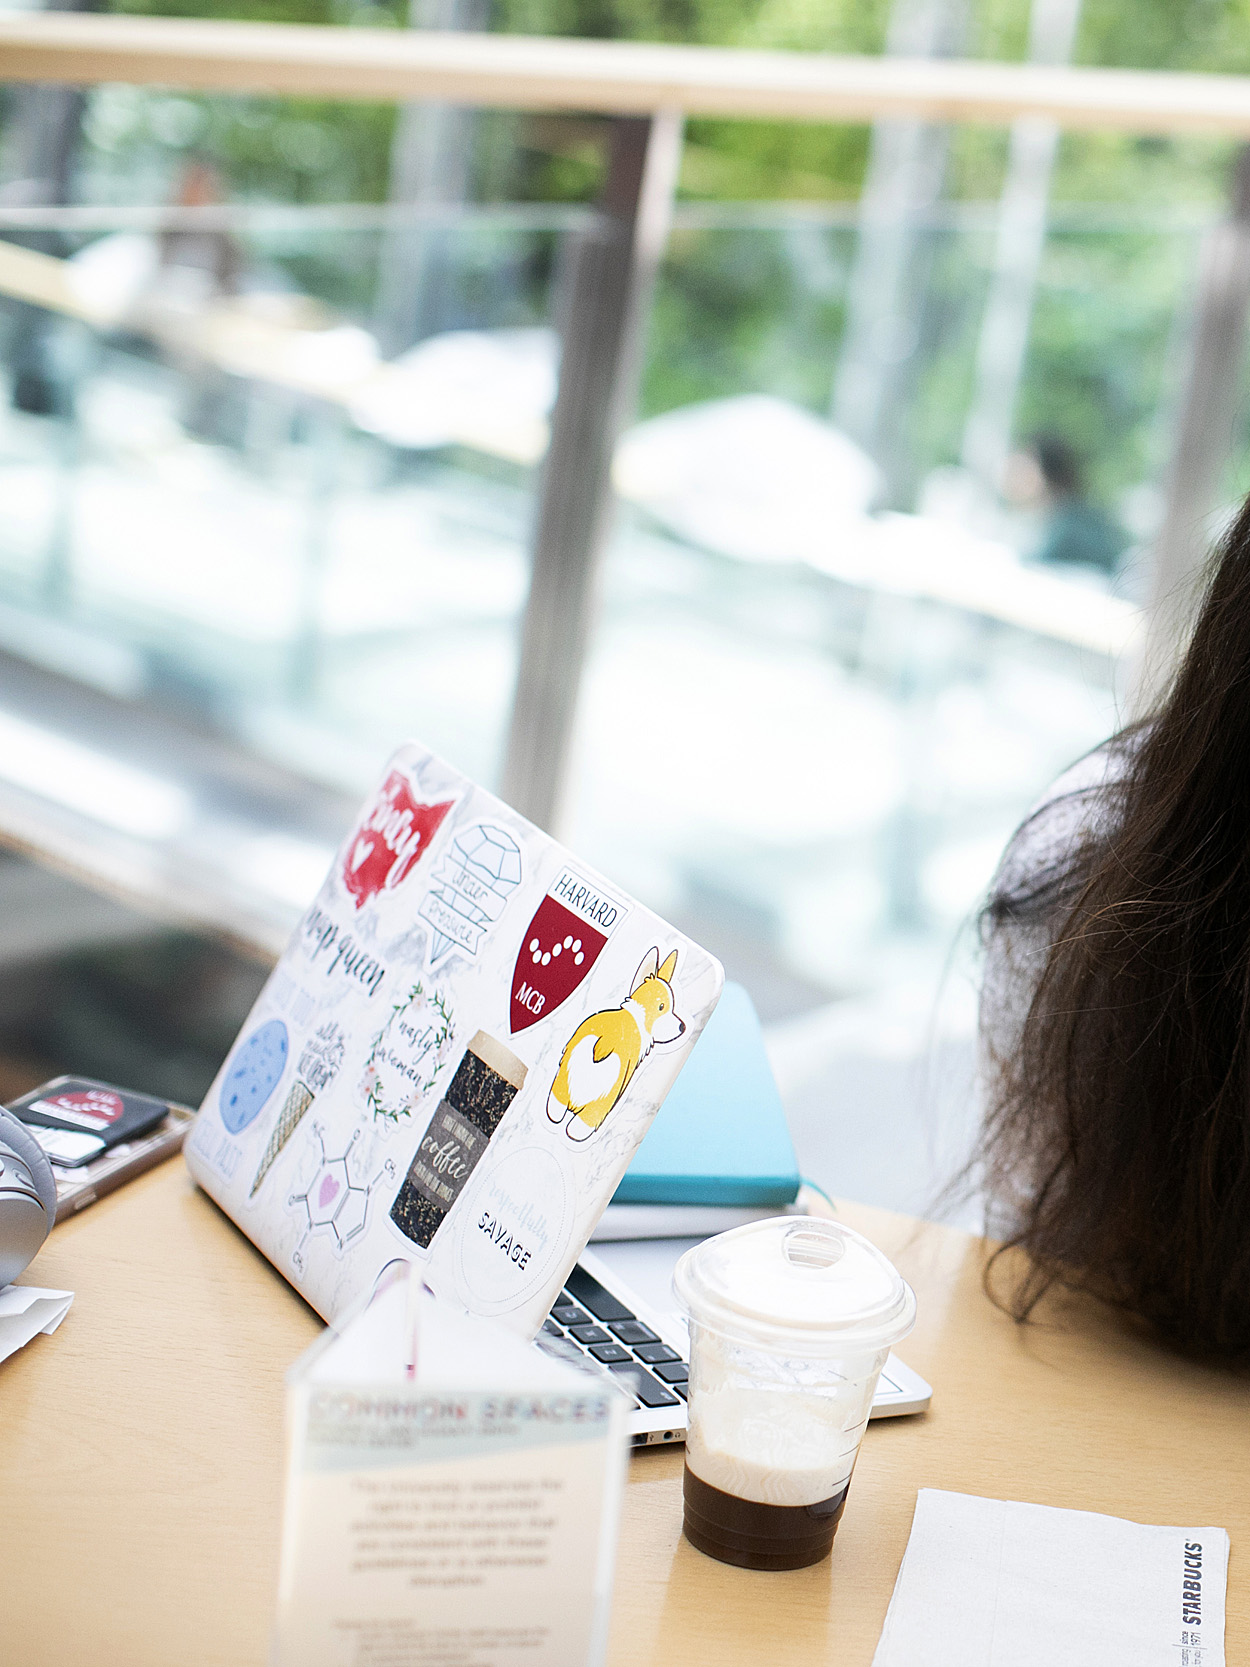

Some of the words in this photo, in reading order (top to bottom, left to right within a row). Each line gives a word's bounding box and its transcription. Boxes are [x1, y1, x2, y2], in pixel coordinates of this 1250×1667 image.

[554, 874, 618, 928] HARVARD
[327, 934, 386, 998] queen
[515, 981, 546, 1016] MCB
[399, 1021, 433, 1066] nasty
[376, 1047, 422, 1087] woman
[421, 1136, 468, 1179] coffee
[489, 1181, 549, 1252] respectfully
[478, 1212, 532, 1271] SAVAGE
[309, 1396, 467, 1421] COMMON
[481, 1396, 609, 1423] SPACES
[1182, 1542, 1203, 1626] STARBUCKS
[1180, 1631, 1188, 1645] since
[1190, 1632, 1201, 1646] 1971
